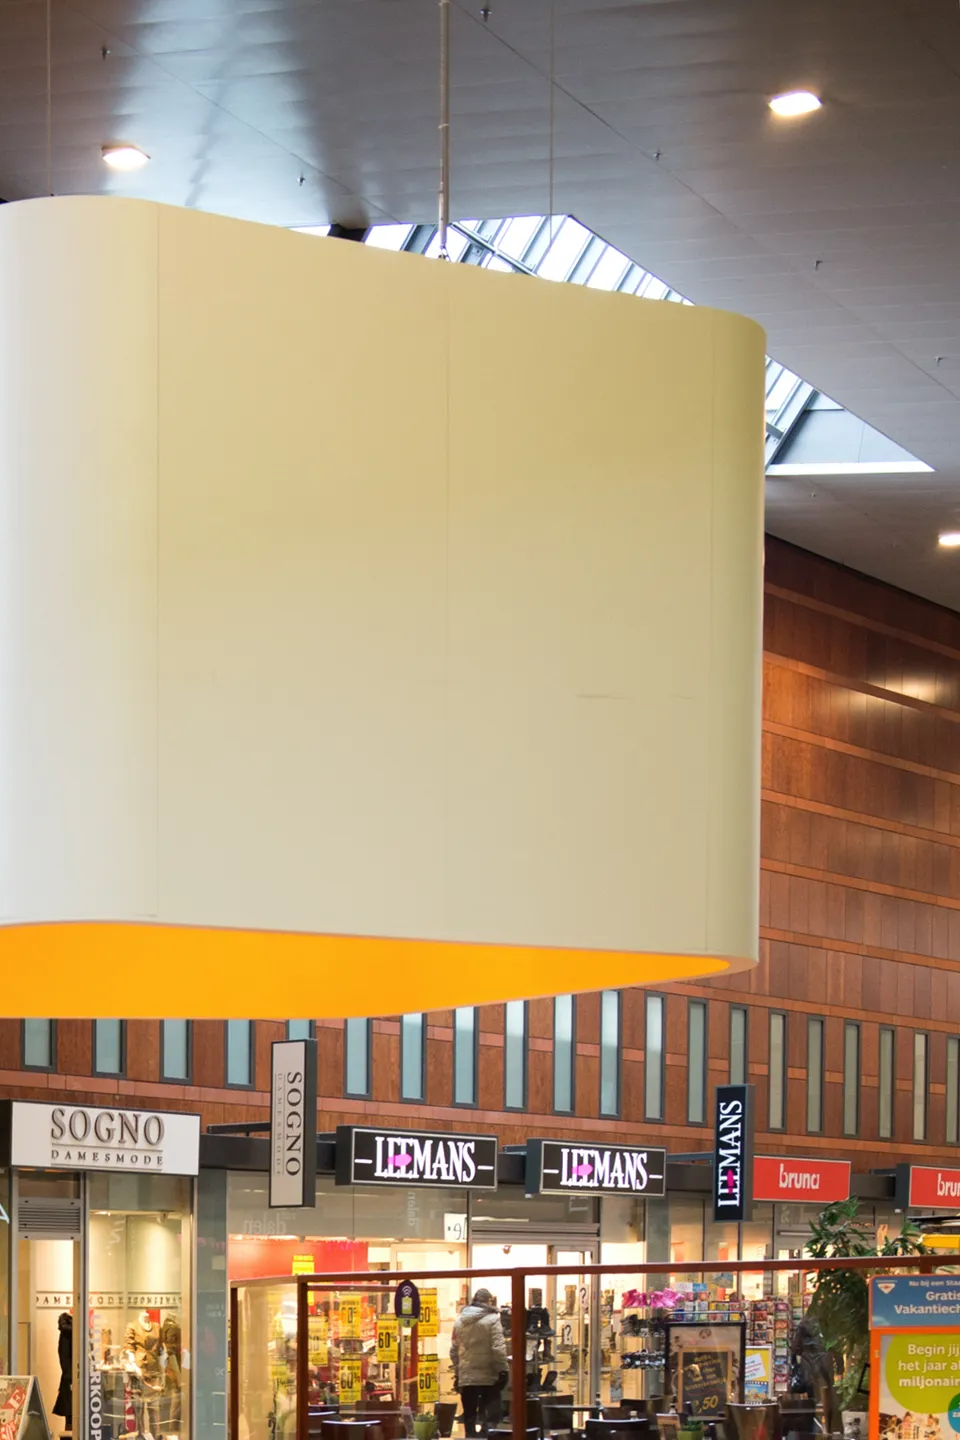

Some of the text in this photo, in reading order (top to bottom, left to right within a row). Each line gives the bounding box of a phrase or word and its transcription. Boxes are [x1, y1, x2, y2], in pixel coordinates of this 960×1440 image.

[51, 1107, 165, 1146] SOGNO
[274, 1073, 283, 1176] DAMESMODE
[286, 1071, 302, 1176] SOGNO
[51, 1149, 163, 1165] DAMESMODE
[374, 1136, 476, 1183] LEEMANS
[560, 1148, 648, 1190] LEEMANS
[718, 1100, 742, 1207] LEEMANS
[779, 1162, 820, 1190] bruna
[898, 1359, 920, 1371] het
[922, 1359, 948, 1374] jaar
[907, 1343, 960, 1358] Begin jij
